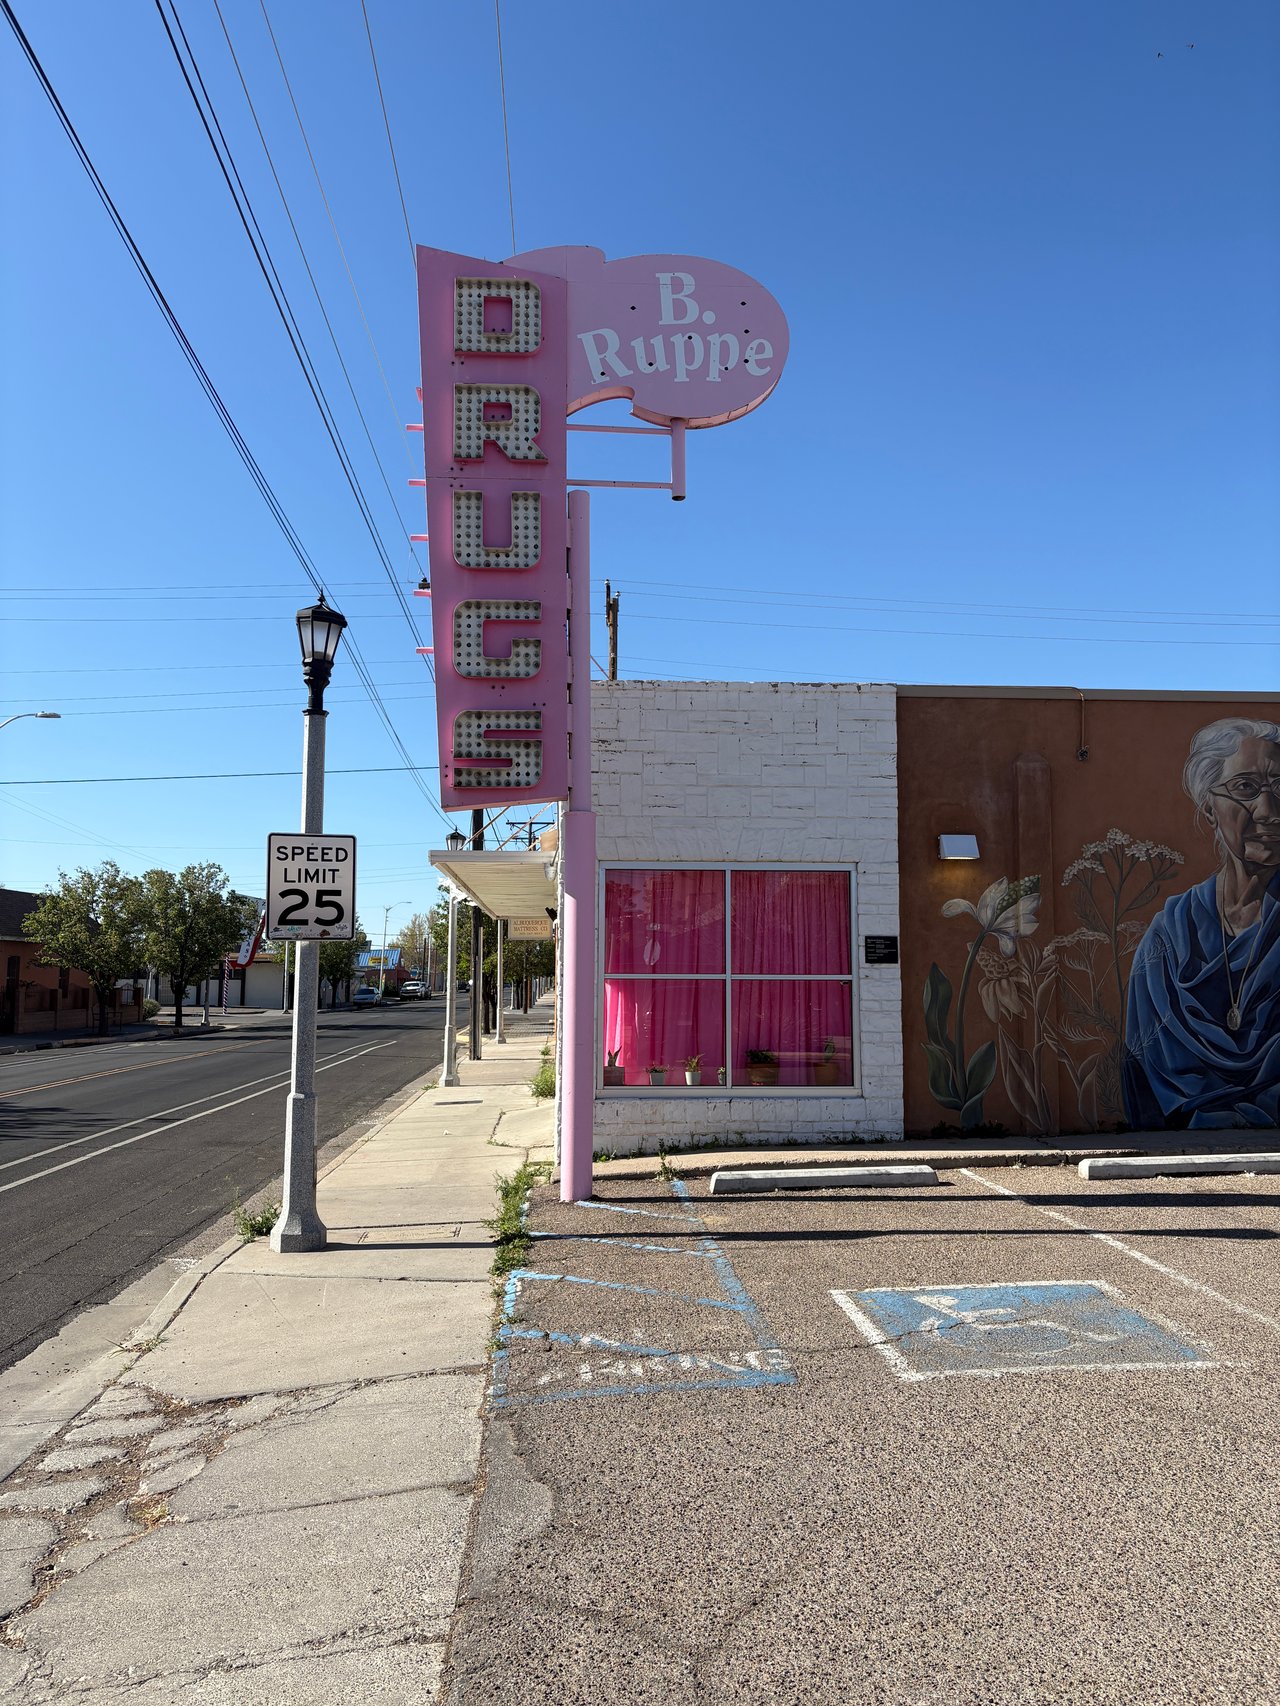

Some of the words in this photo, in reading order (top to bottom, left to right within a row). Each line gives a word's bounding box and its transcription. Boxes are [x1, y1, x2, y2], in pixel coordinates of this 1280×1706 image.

[656, 272, 716, 325] B.
[577, 328, 773, 384] Ruppe
[453, 276, 548, 789] DRUGS
[276, 845, 348, 862] SPEED
[283, 867, 340, 883] LIMIT
[277, 888, 345, 927] 25
